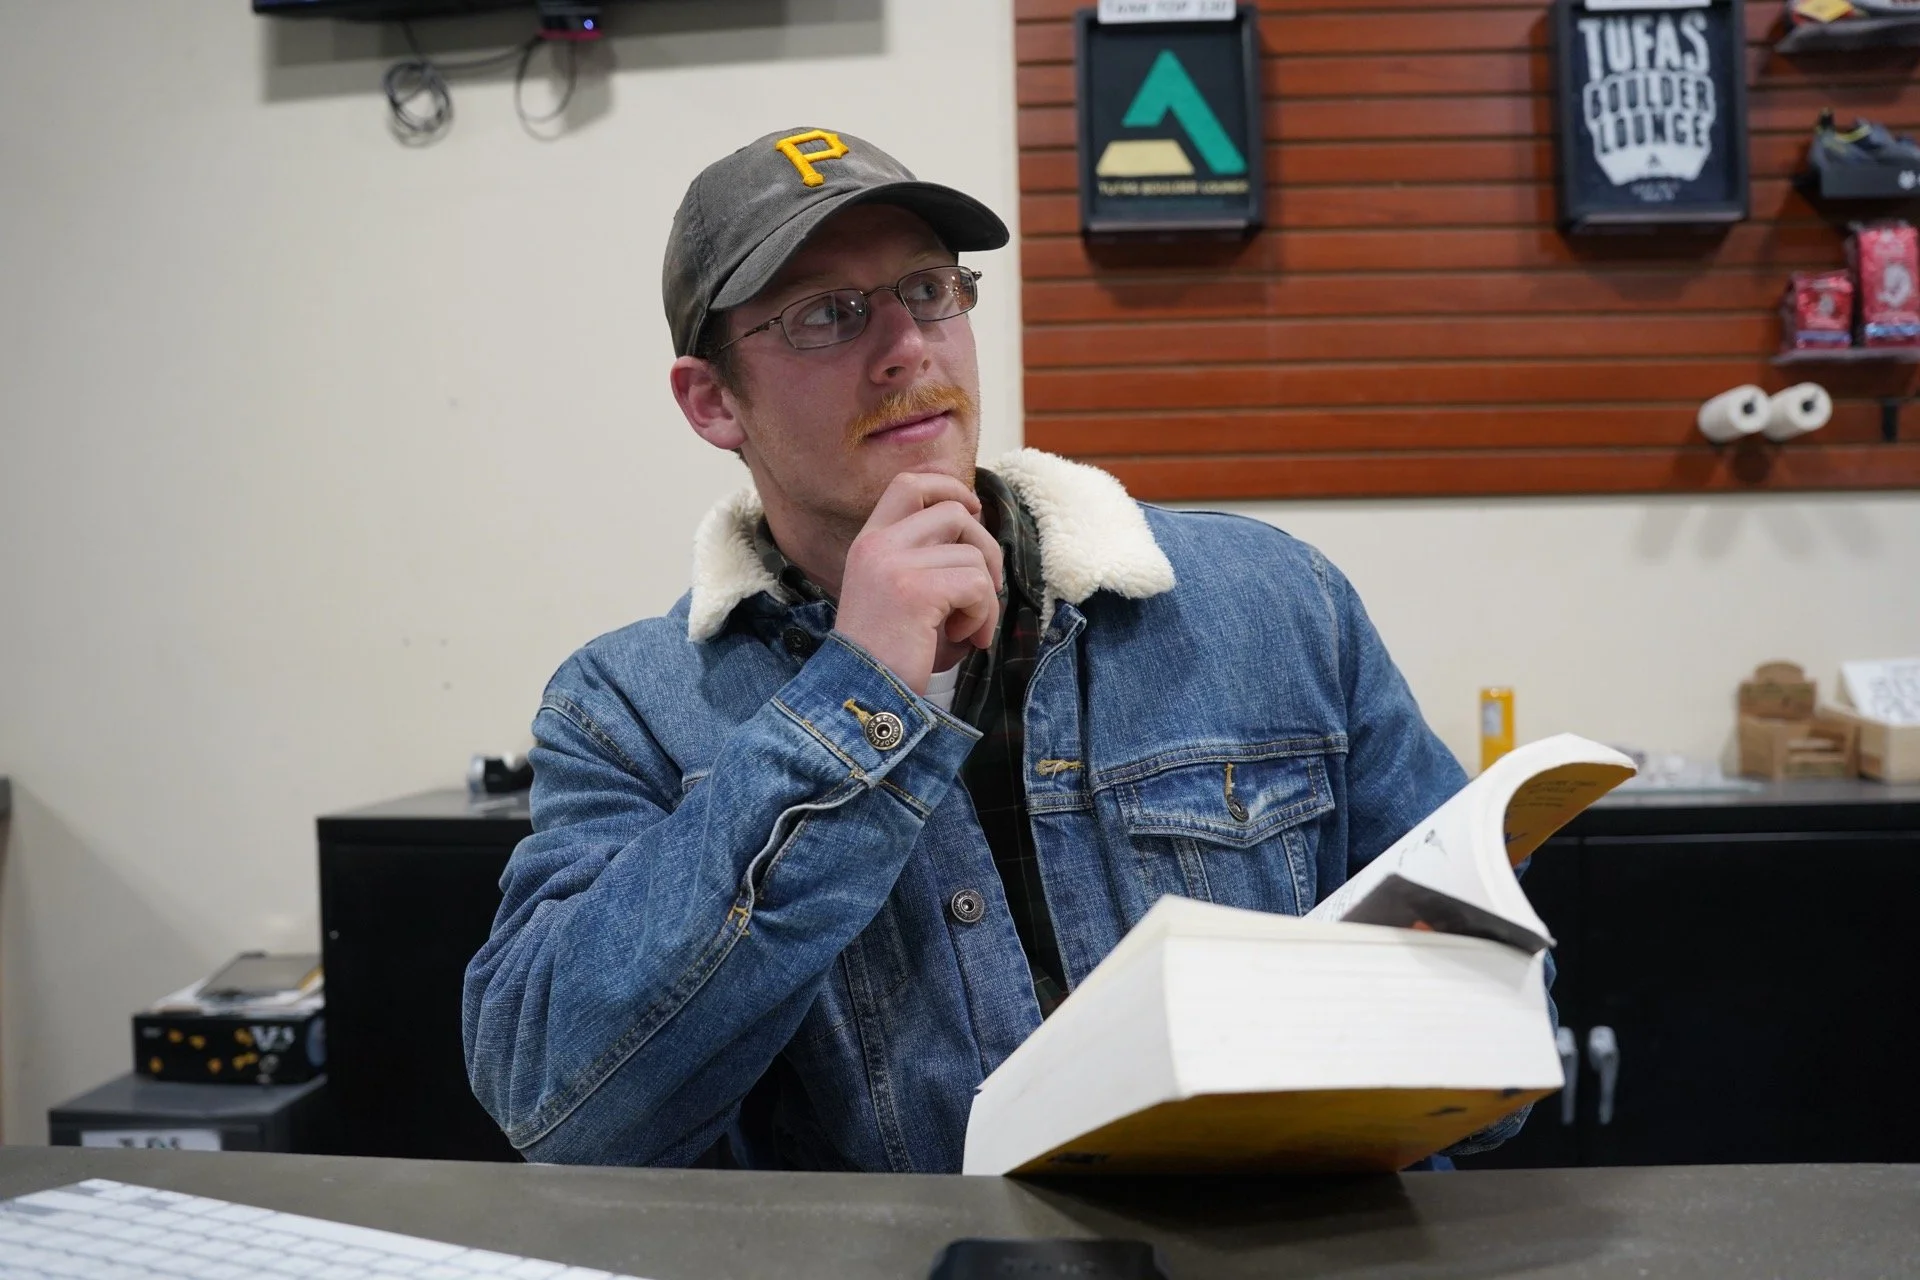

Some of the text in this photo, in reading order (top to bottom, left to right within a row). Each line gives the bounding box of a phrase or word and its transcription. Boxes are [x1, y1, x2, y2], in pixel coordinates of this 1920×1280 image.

[1577, 11, 1710, 82] TUFAS
[1587, 74, 1713, 121] BOULDER
[775, 130, 849, 188] P
[1597, 113, 1709, 154] LOUNGE
